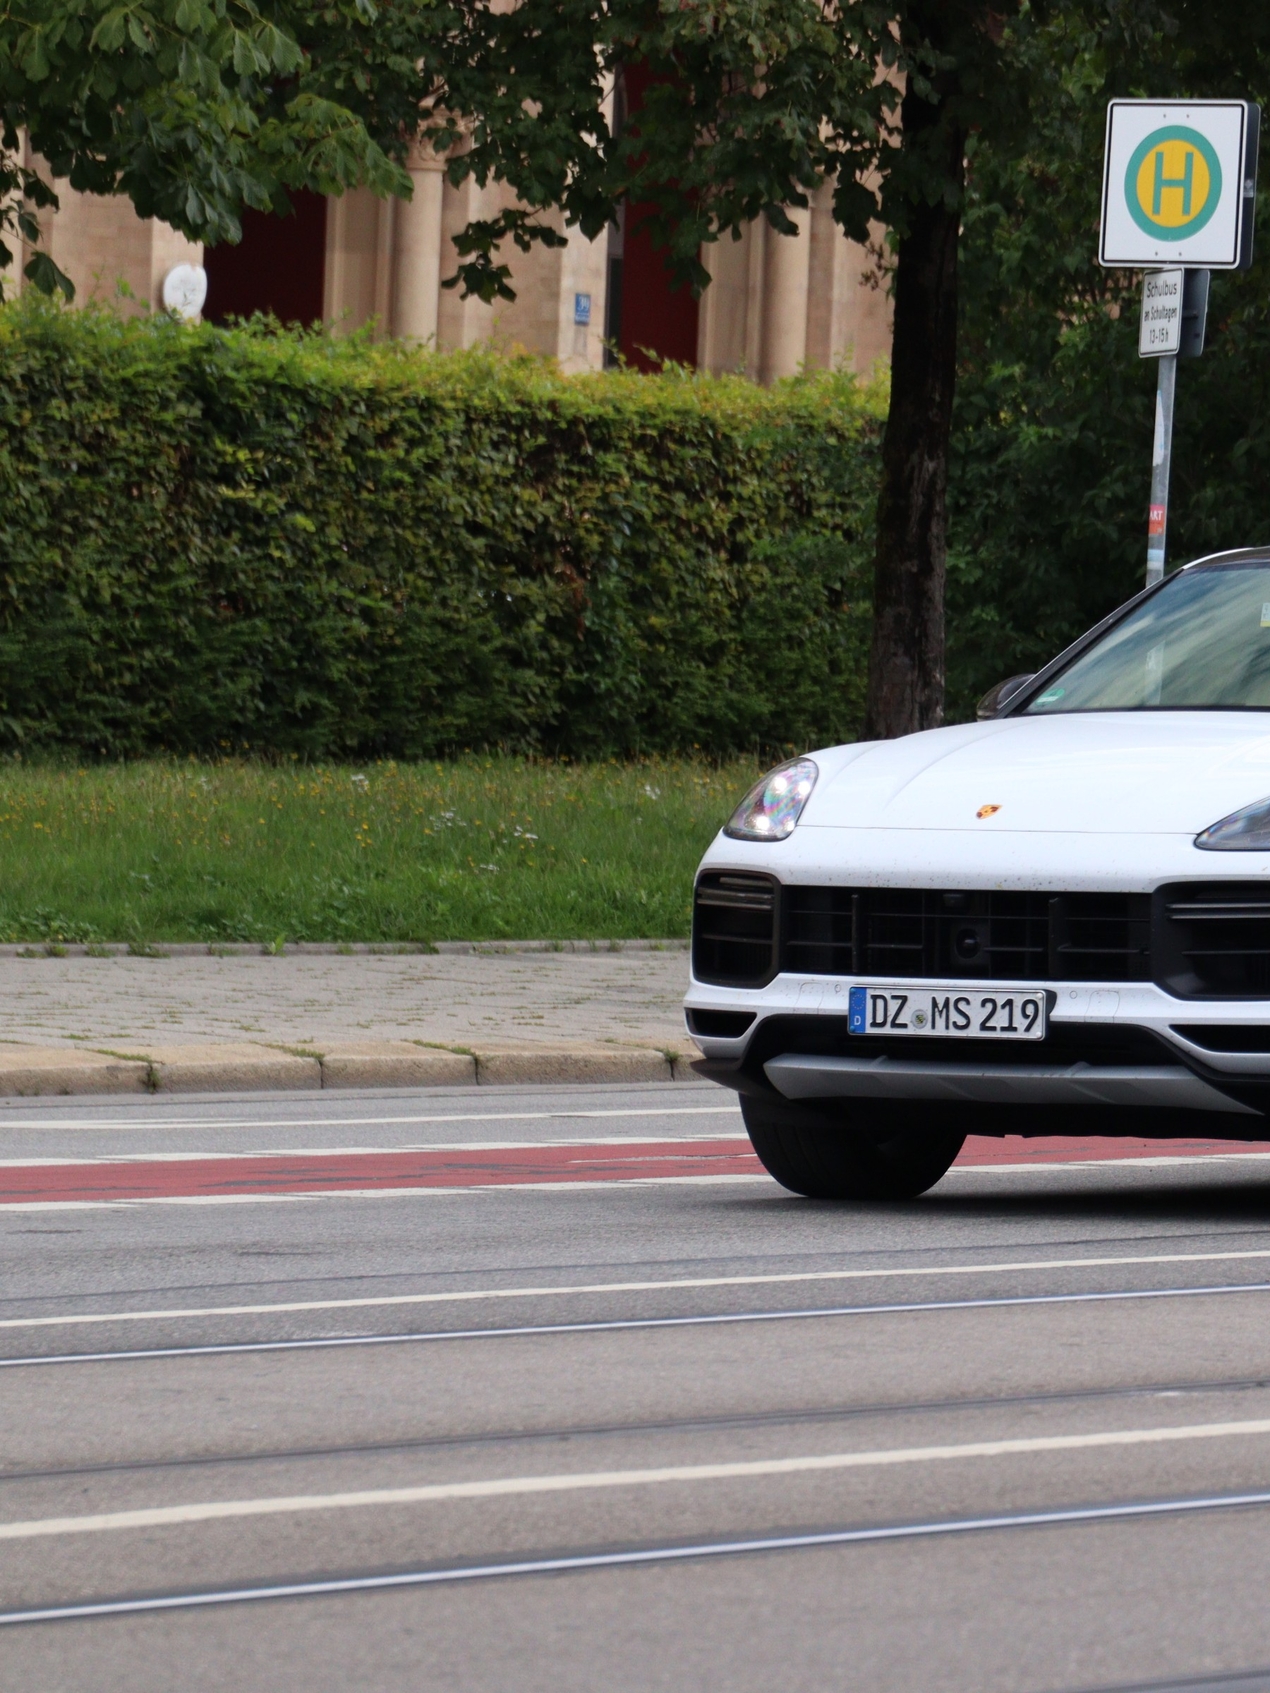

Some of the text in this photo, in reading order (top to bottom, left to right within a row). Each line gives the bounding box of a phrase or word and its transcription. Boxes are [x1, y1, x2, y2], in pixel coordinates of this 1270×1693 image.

[1152, 151, 1194, 216] H
[1146, 280, 1177, 299] Schulbus
[1150, 305, 1178, 323] Schultagen
[853, 1016, 861, 1026] D
[869, 994, 1039, 1033] DZ MS 219
